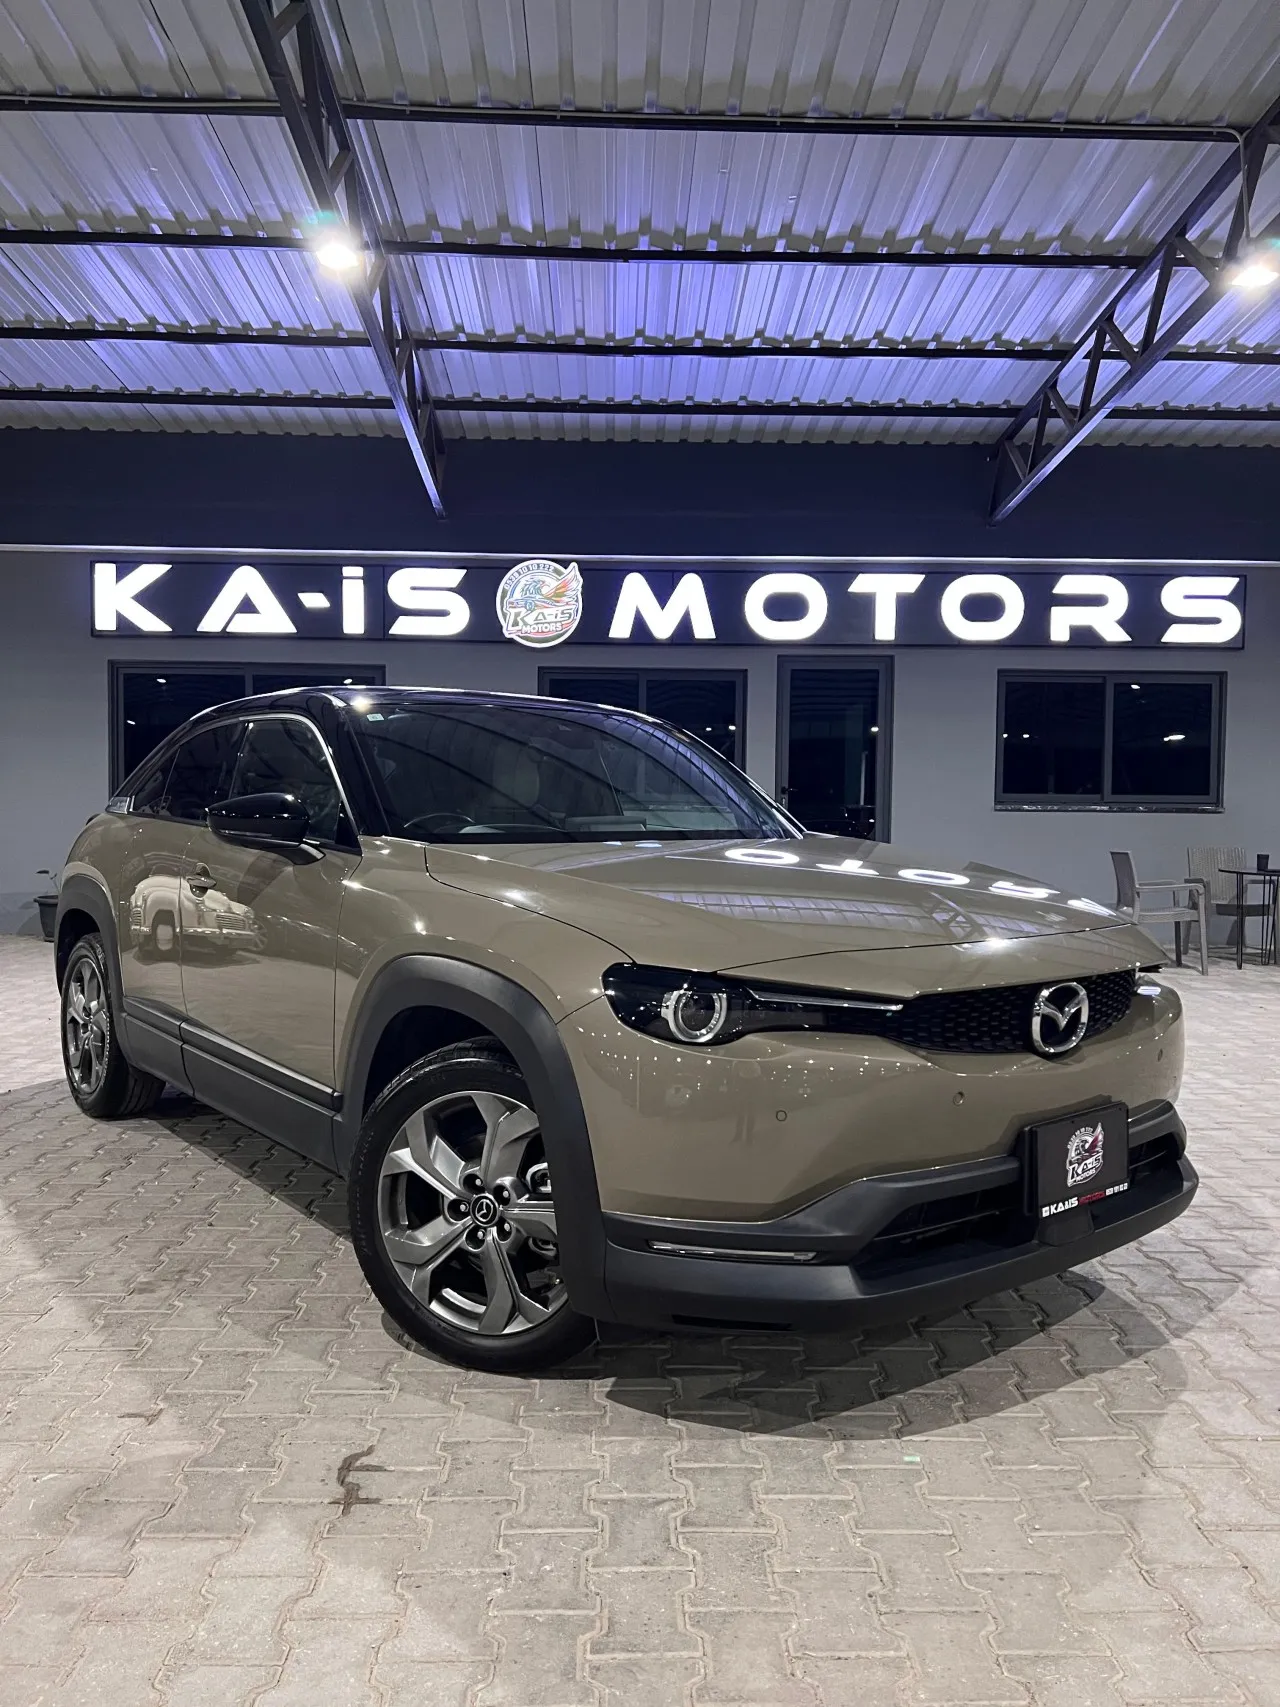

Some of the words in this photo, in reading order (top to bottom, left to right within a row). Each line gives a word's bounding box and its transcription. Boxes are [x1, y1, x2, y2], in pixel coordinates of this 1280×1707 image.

[529, 563, 538, 571] 10
[608, 571, 1243, 644] MOTORS
[522, 623, 563, 634] MOTORS
